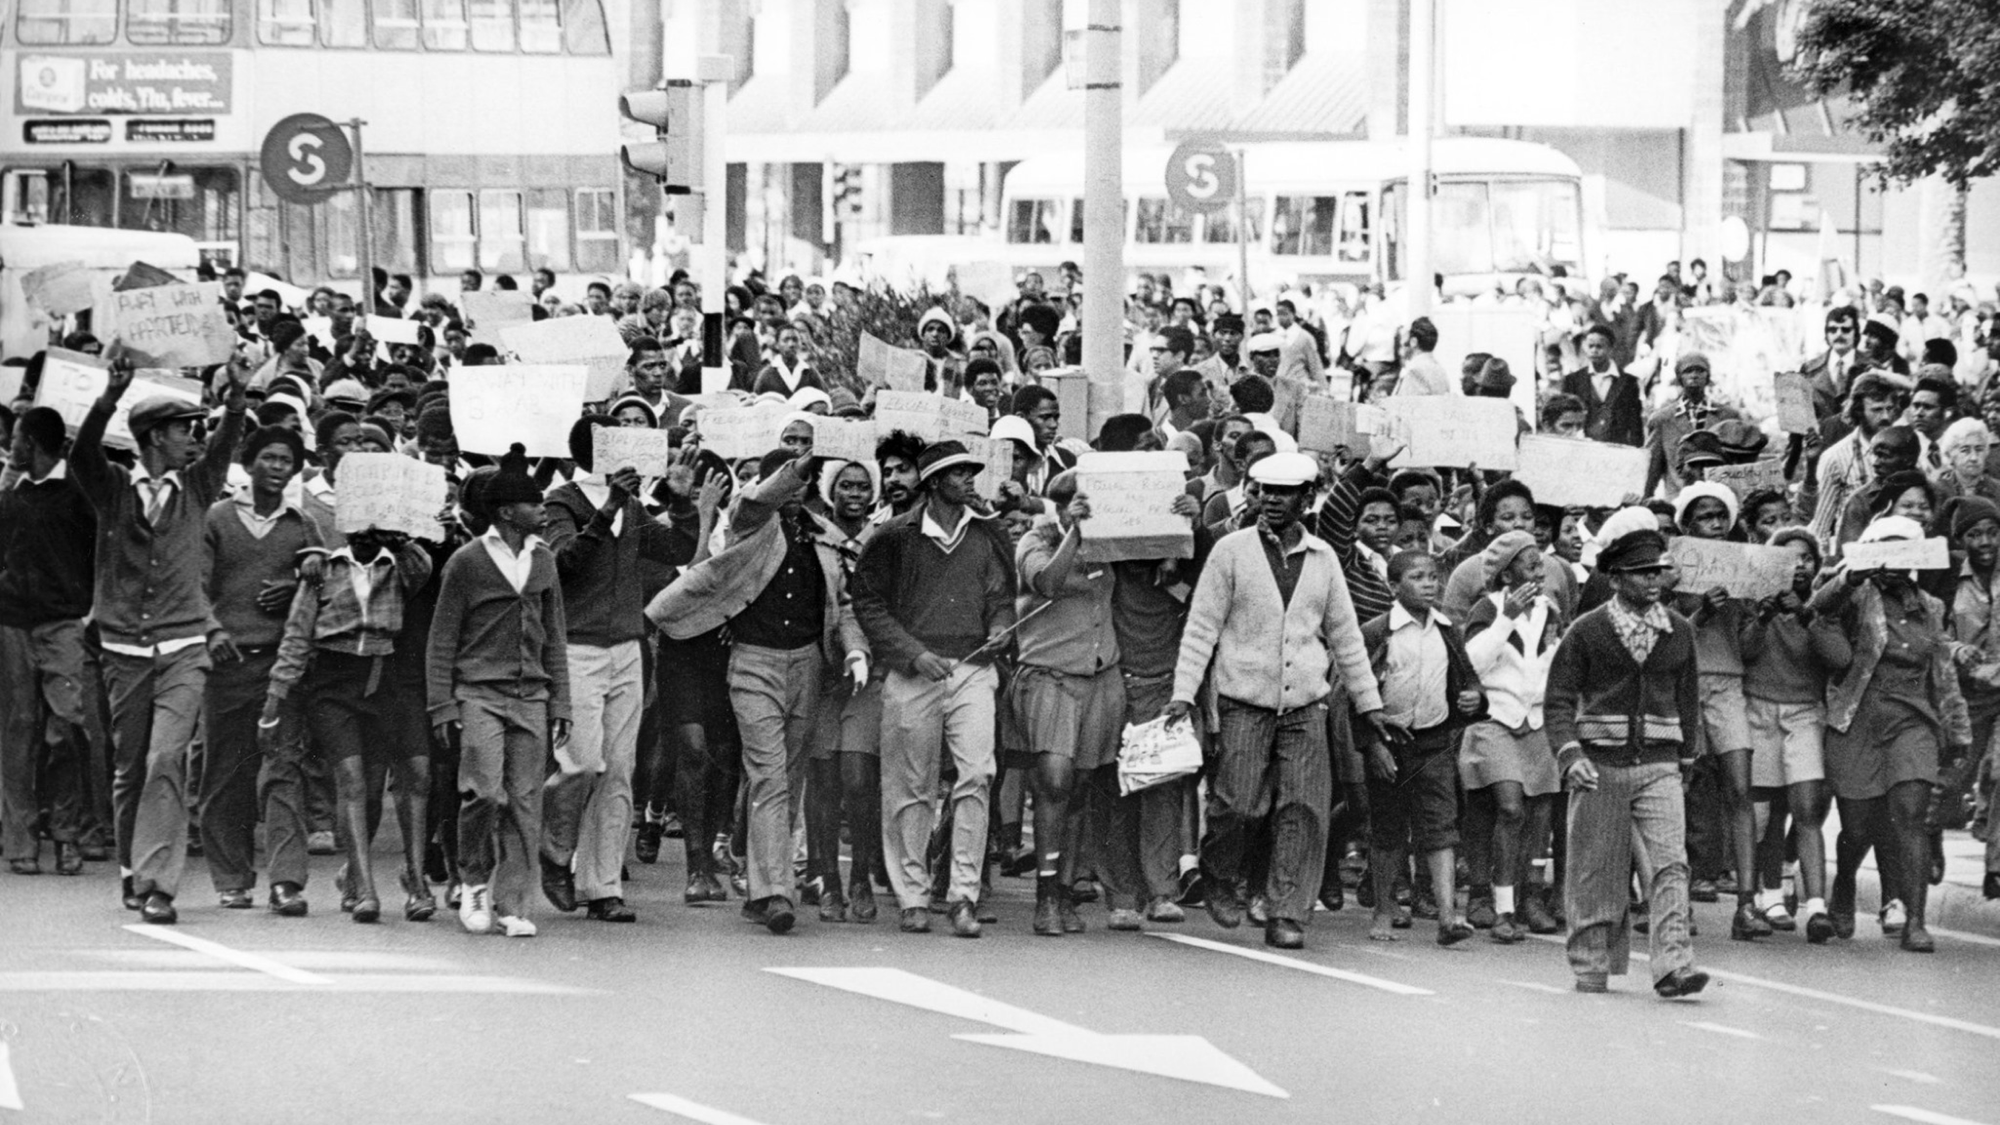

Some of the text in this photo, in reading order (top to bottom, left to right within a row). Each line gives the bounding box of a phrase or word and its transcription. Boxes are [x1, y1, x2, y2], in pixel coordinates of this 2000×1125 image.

[88, 58, 218, 83] For headaches,
[88, 86, 137, 110] colds,
[288, 133, 326, 185] S
[1185, 153, 1219, 199] S
